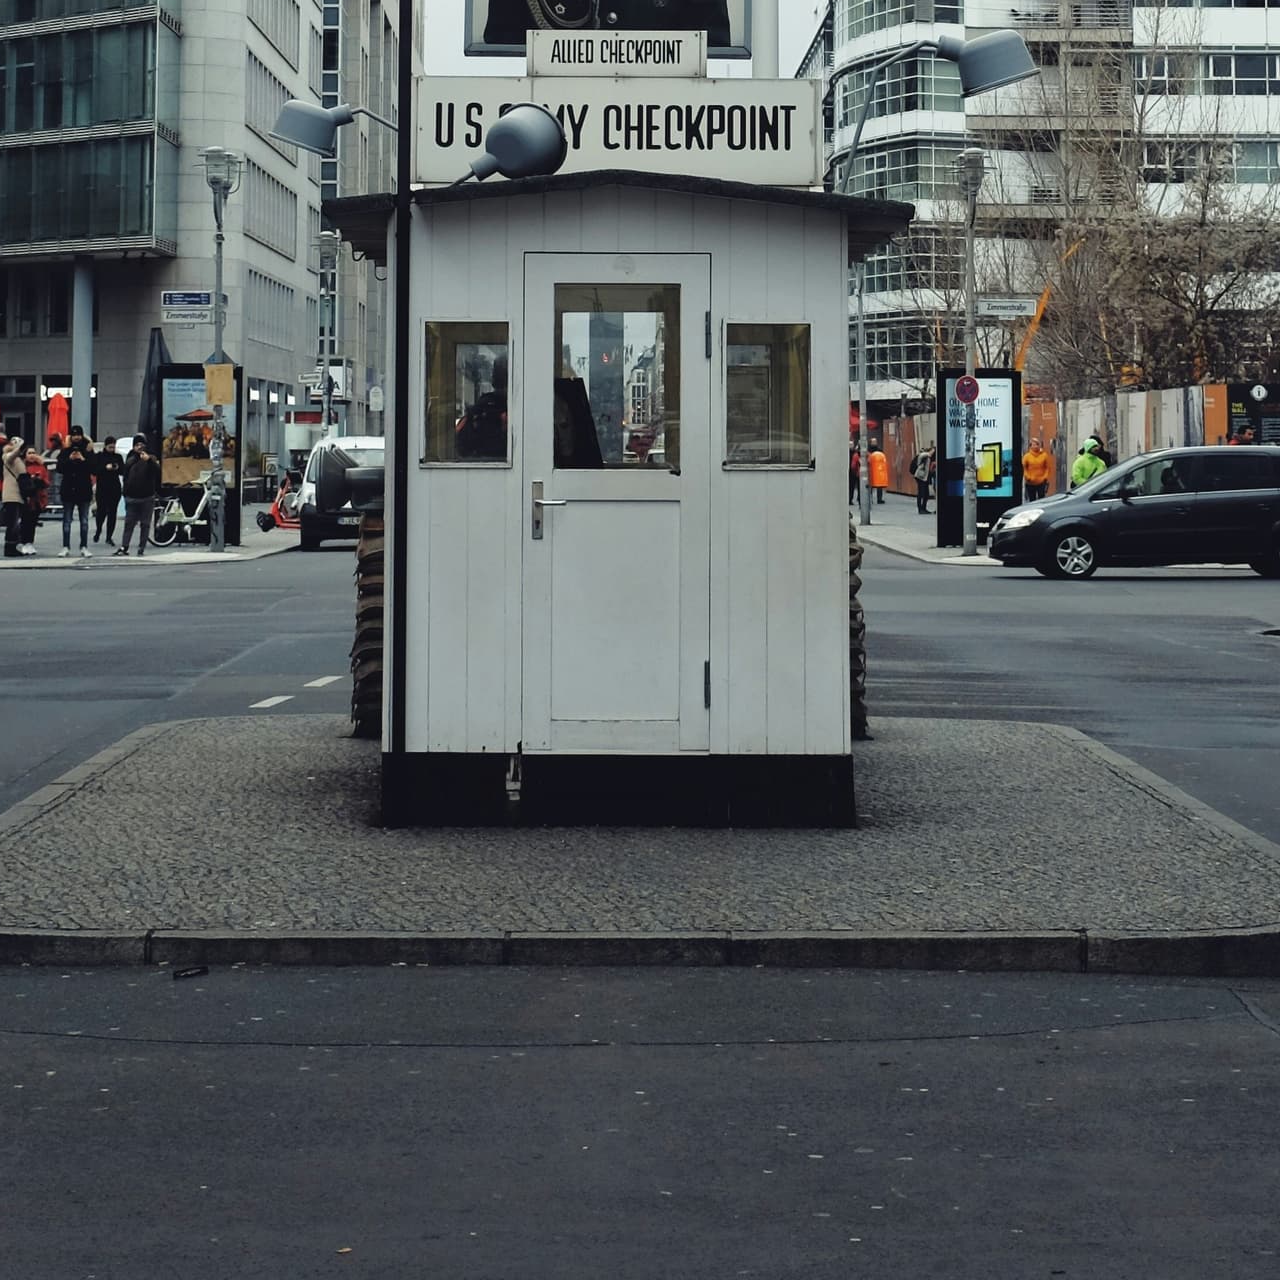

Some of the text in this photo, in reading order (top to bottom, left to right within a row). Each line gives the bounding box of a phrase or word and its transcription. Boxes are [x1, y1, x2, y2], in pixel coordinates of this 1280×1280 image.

[551, 39, 683, 65] ALLIED CHECKPOINT
[603, 103, 798, 151] CHECKPOINT
[977, 397, 1000, 408] HOME
